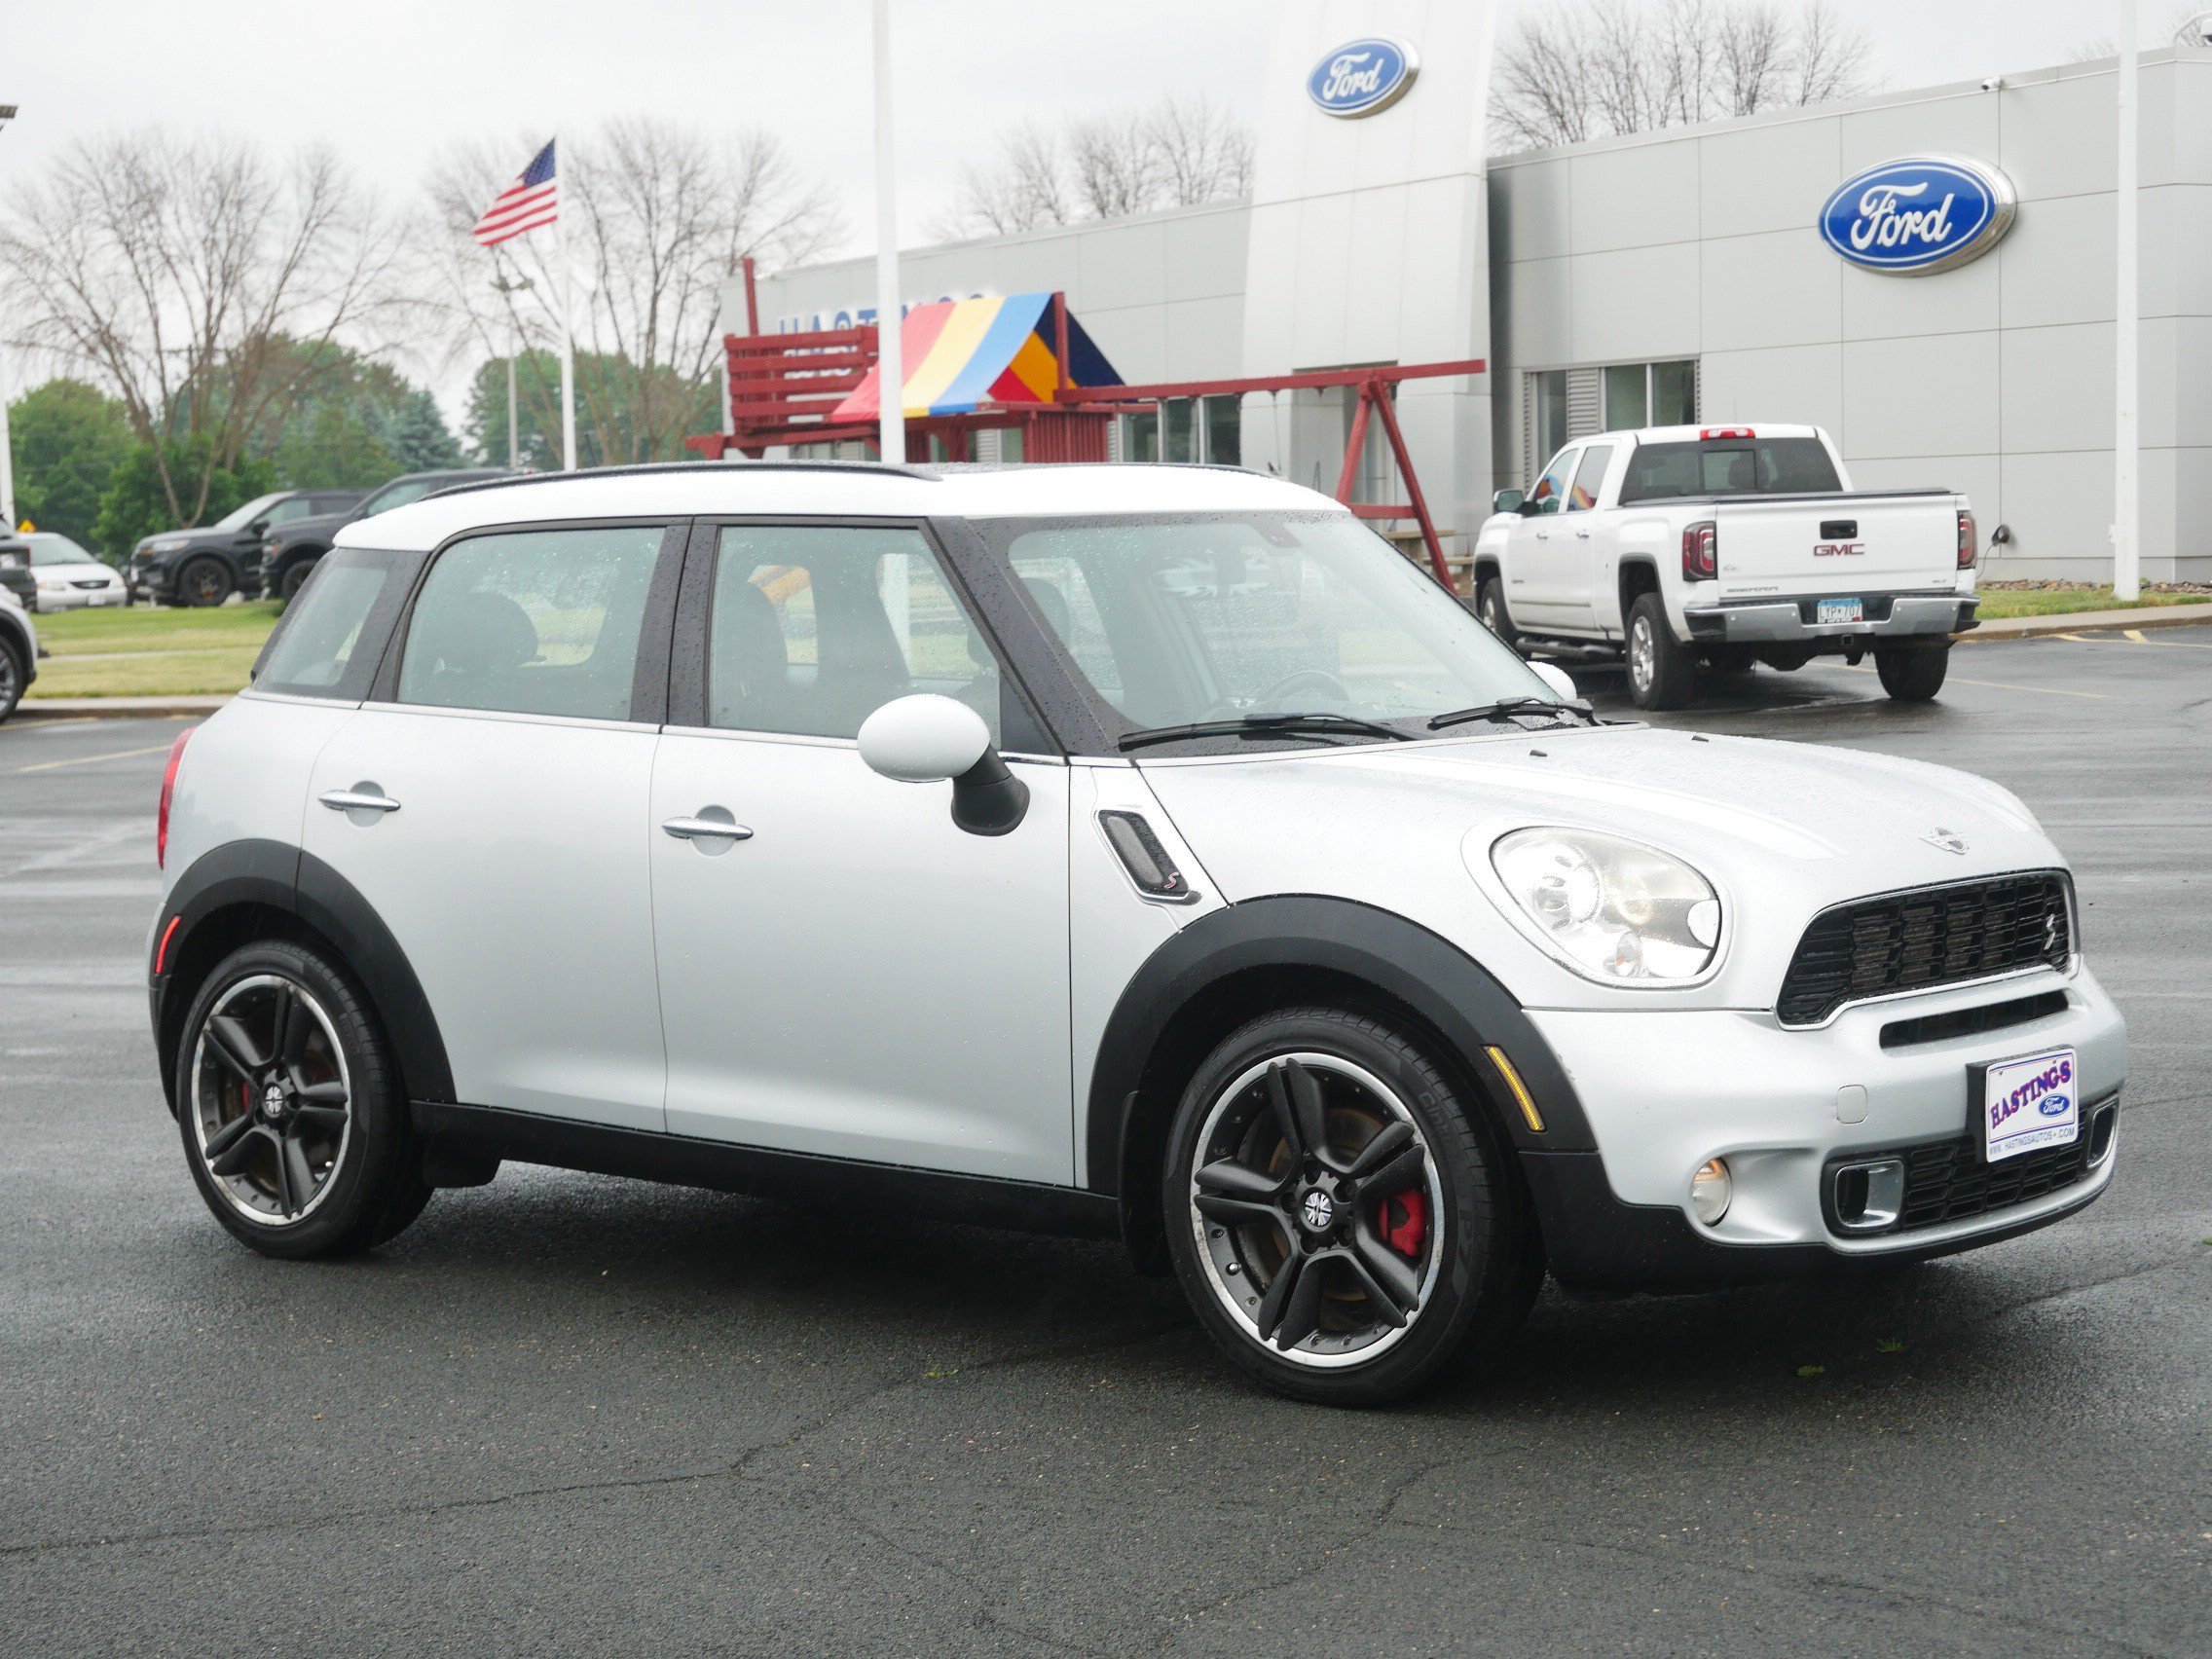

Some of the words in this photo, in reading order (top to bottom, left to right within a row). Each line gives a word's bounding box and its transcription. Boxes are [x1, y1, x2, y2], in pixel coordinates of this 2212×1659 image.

[1322, 52, 1384, 100] Ford
[1851, 182, 1955, 250] Ford
[1814, 543, 1865, 556] GMC
[1990, 1059, 2072, 1129] HASTINGS
[2043, 1096, 2066, 1114] Ford
